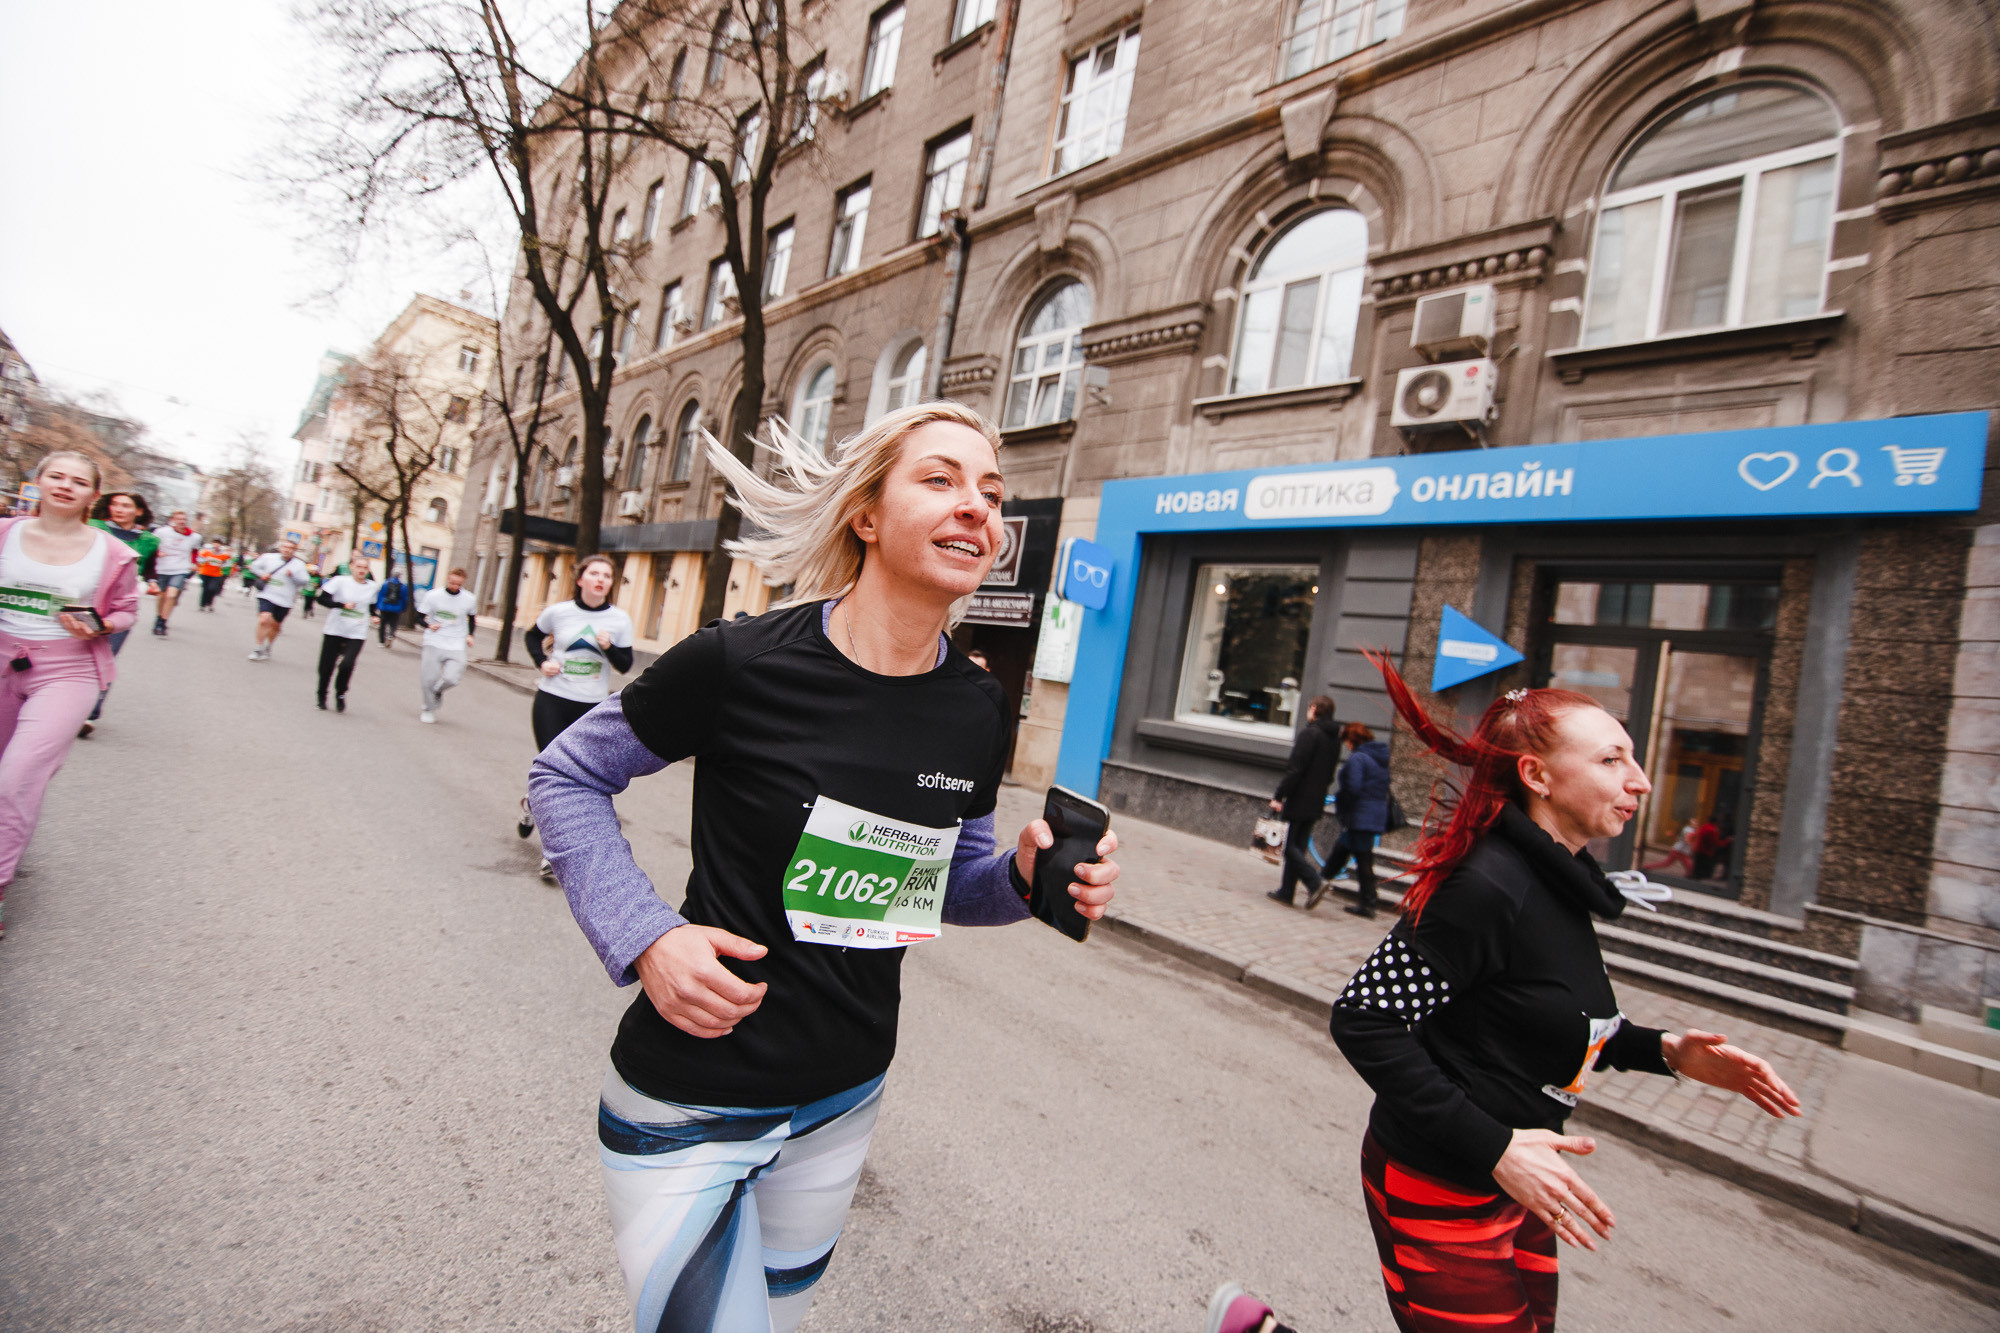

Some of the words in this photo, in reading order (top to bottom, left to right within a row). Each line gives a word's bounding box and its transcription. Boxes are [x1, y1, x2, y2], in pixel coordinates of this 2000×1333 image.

[1155, 488, 1240, 514] новая
[1259, 479, 1376, 509] оптика
[1411, 461, 1575, 502] онлайн
[0, 593, 48, 610] 20340
[917, 772, 975, 793] softserve
[872, 824, 941, 847] HERBALIFE
[867, 835, 938, 856] NUTRITION
[911, 867, 943, 877] FAMILY
[786, 858, 898, 906] 21062
[903, 875, 938, 892] RUN
[894, 896, 909, 908] 1,6
[913, 896, 934, 911] KM
[866, 933, 889, 941] AIRLINES
